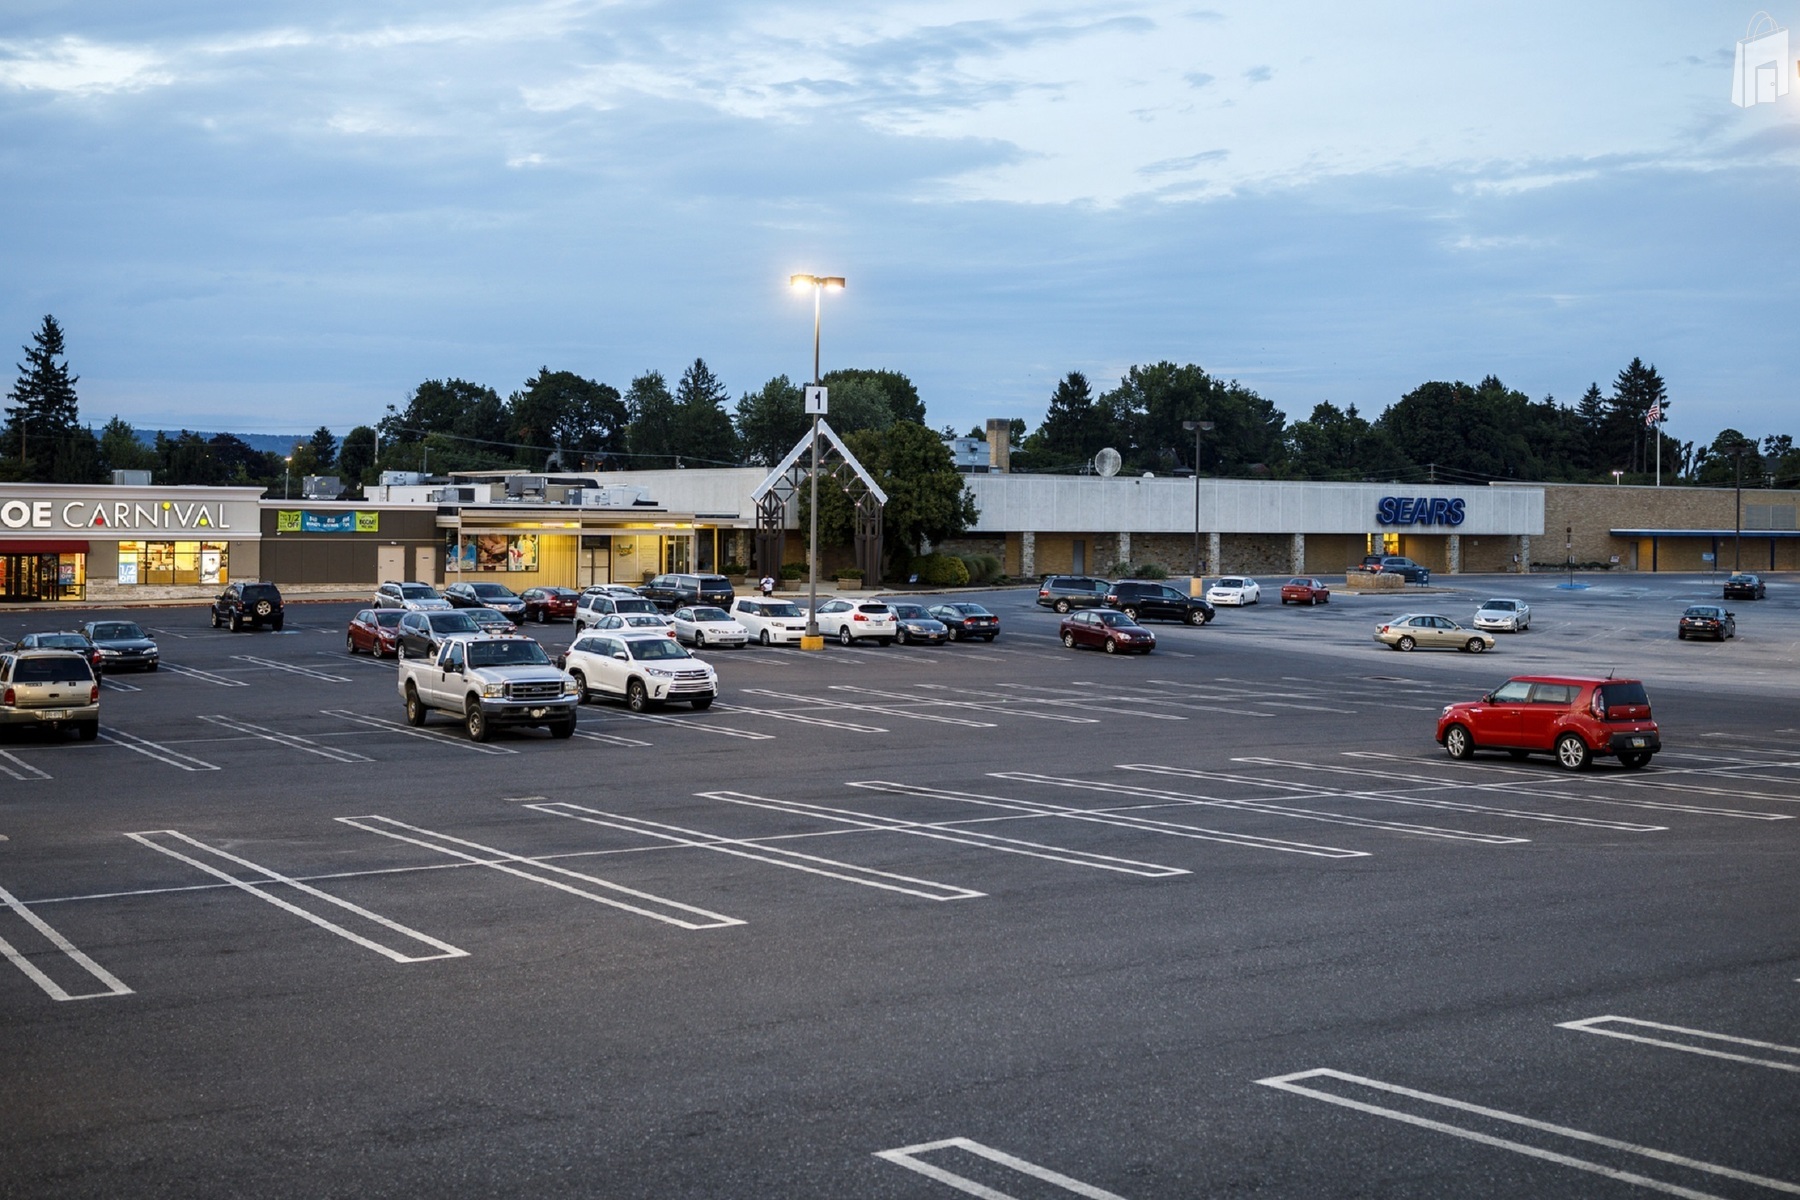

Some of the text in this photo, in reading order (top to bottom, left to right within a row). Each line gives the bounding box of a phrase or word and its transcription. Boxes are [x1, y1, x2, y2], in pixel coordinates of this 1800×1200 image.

[815, 391, 820, 410] 1
[1, 500, 51, 528] OE
[287, 514, 300, 522] 1/2
[1376, 497, 1465, 526] SEARS
[61, 566, 73, 574] 1/2
[119, 564, 136, 575] 1/2
